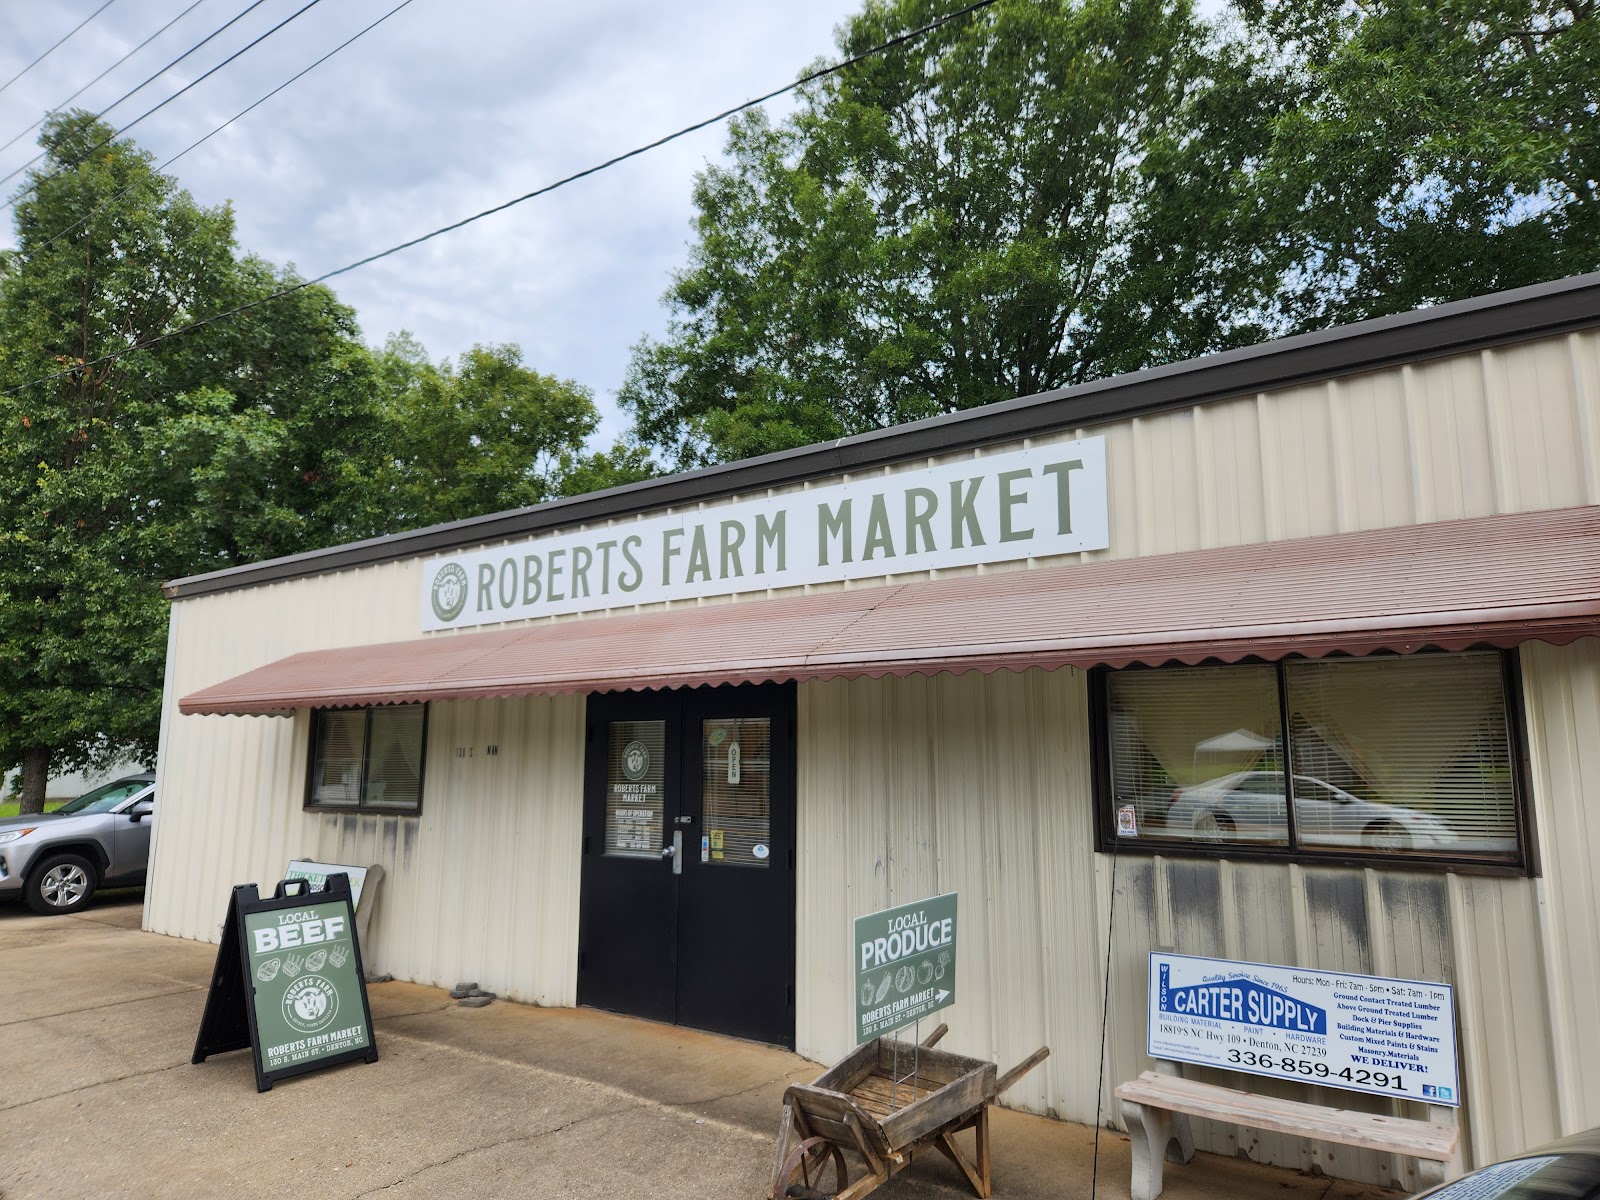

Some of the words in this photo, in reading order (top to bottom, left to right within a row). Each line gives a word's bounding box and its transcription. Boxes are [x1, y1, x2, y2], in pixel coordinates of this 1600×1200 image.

[476, 535, 643, 612] ROBERTS
[661, 509, 787, 587] FARM
[817, 458, 1084, 567] MARKET
[614, 784, 639, 793] ROBERTS
[640, 784, 656, 794] FARM
[622, 794, 646, 802] MARKET
[289, 871, 326, 883] THICKET
[278, 910, 319, 925] LOCAL
[888, 911, 927, 934] LOCAL
[253, 916, 344, 953] BEEF
[861, 918, 952, 970] PRODUCE
[285, 978, 313, 1004] ROBERTS
[316, 979, 334, 996] FARM
[1160, 965, 1168, 1010] WILSON
[1202, 974, 1225, 982] Quality
[1228, 971, 1250, 979] Service
[1252, 974, 1269, 986] Since
[1271, 982, 1288, 993] 1965
[1292, 975, 1314, 985] Hours:
[1316, 978, 1330, 987] Mon
[1336, 980, 1347, 989] Fri:
[1349, 982, 1364, 992] 7am
[1370, 984, 1385, 994] 5pm
[1392, 987, 1406, 996] Sat:
[1408, 988, 1423, 998] 7am
[1429, 991, 1445, 1001] 1pm
[862, 1004, 892, 1025] ROBERTS
[892, 997, 909, 1013] FARM
[910, 987, 934, 1006] MARKET
[1174, 987, 1243, 1021] CARTER
[1248, 989, 1318, 1031] SUPPLY
[1333, 992, 1358, 1001] Ground
[1359, 995, 1386, 1005] Contact
[1386, 998, 1412, 1008] Treated
[1414, 1002, 1440, 1011] Lumber
[1337, 1003, 1356, 1011] Above
[1358, 1005, 1383, 1014] Ground
[1384, 1008, 1410, 1018] Treated
[1412, 1012, 1438, 1022] Lumber
[880, 1017, 894, 1029] MAIN
[895, 1014, 903, 1023] ST.
[1159, 1014, 1189, 1024] BUILDING
[1190, 1018, 1222, 1029] MATERIAL
[1244, 1026, 1263, 1035] PAINT
[1285, 1032, 1326, 1045] HARDWARE
[1337, 1023, 1364, 1034] Building
[1366, 1026, 1396, 1037] Materials
[1405, 1031, 1440, 1043] Hardware
[1352, 1015, 1369, 1023] Dock
[1378, 1018, 1392, 1026] Pier
[1393, 1019, 1422, 1030] Supplies
[267, 1040, 305, 1057] ROBERTS
[307, 1034, 329, 1047] FARM
[330, 1025, 362, 1041] MARKET
[1191, 1028, 1204, 1038] NC
[1206, 1031, 1224, 1044] Hwy
[1227, 1034, 1240, 1044] 109
[1249, 1037, 1282, 1052] Denton,
[1284, 1042, 1298, 1054] NC
[1302, 1045, 1327, 1058] 27239
[1339, 1033, 1364, 1043] Custom
[1365, 1036, 1385, 1046] Mixed
[1386, 1040, 1408, 1049] Paints
[1416, 1043, 1438, 1053] Stains
[270, 1058, 282, 1067] 130
[292, 1051, 309, 1060] MAIN
[311, 1048, 320, 1056] ST.
[326, 1040, 354, 1052] DENTON,
[1351, 1055, 1369, 1064] WE
[1372, 1058, 1428, 1073] DELIVER!
[1227, 1048, 1408, 1091] 336-859-4291
